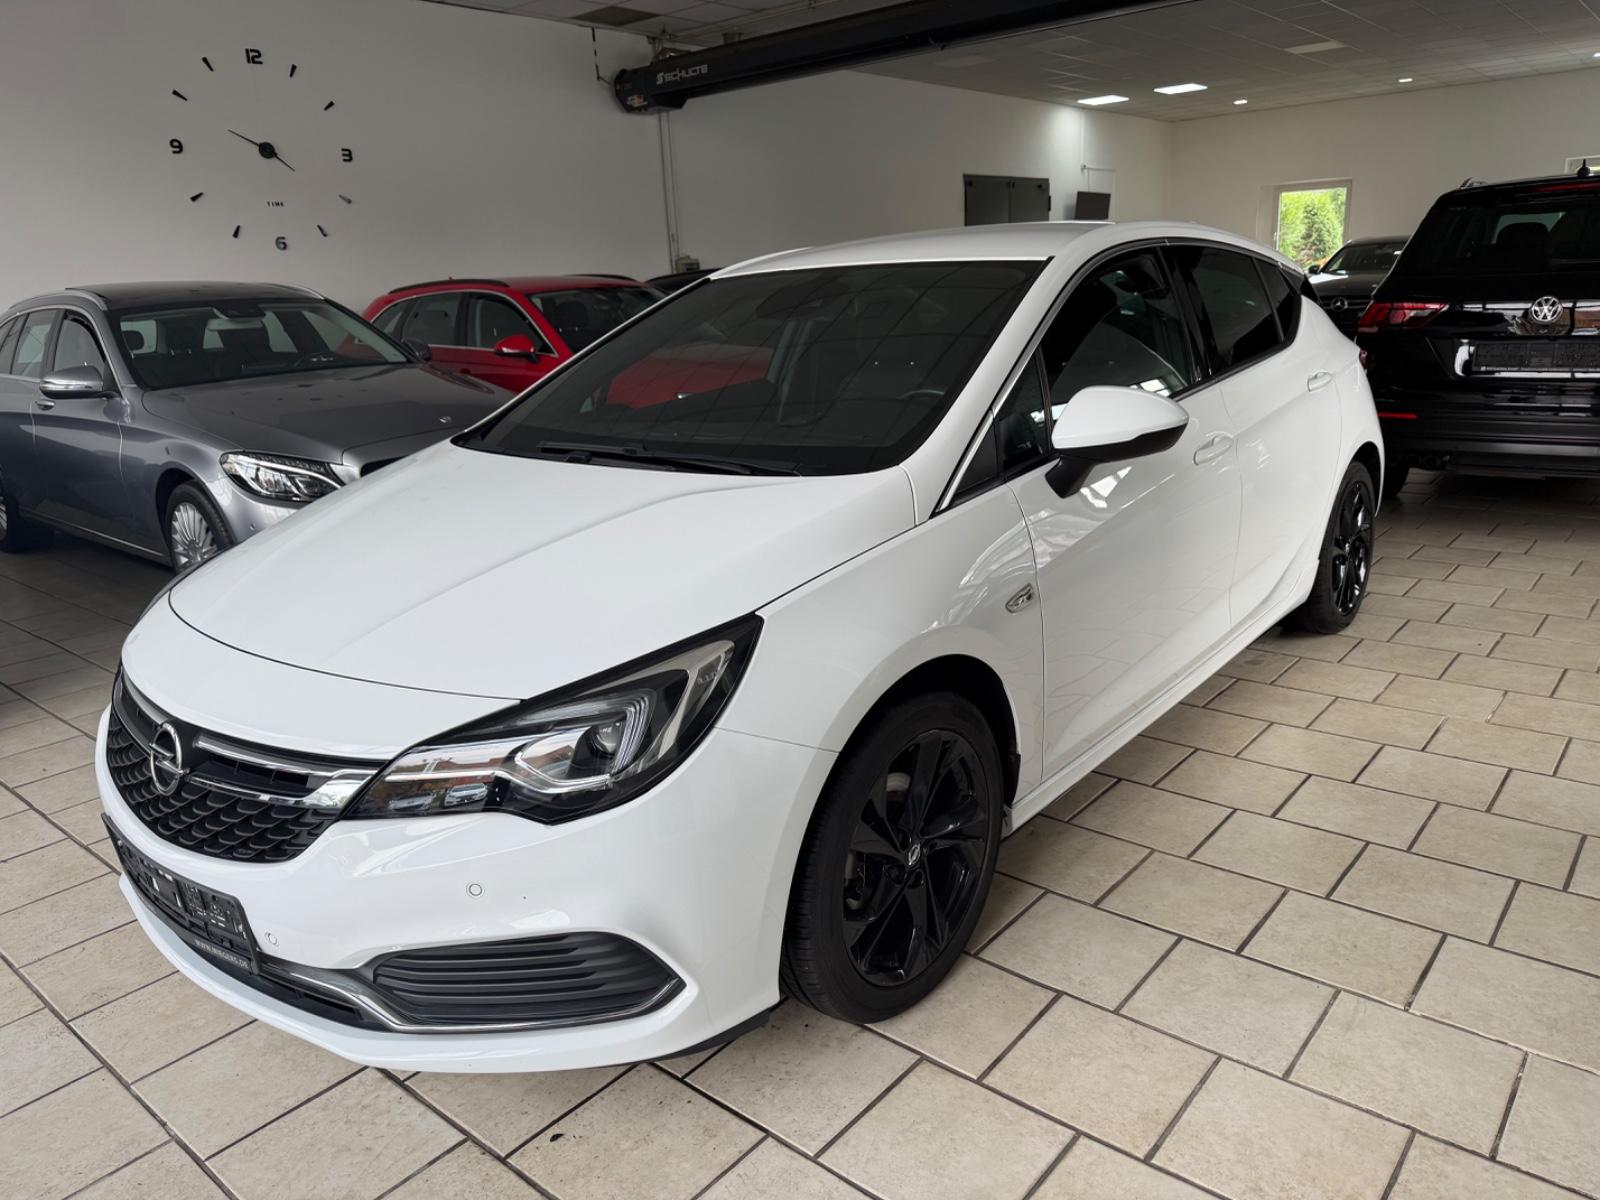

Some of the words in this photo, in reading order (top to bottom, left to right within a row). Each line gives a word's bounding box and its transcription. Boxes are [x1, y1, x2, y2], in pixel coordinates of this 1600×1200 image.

[245, 48, 263, 64] 12
[169, 138, 183, 154] 9
[341, 148, 353, 162] 3
[275, 236, 288, 251] 6
